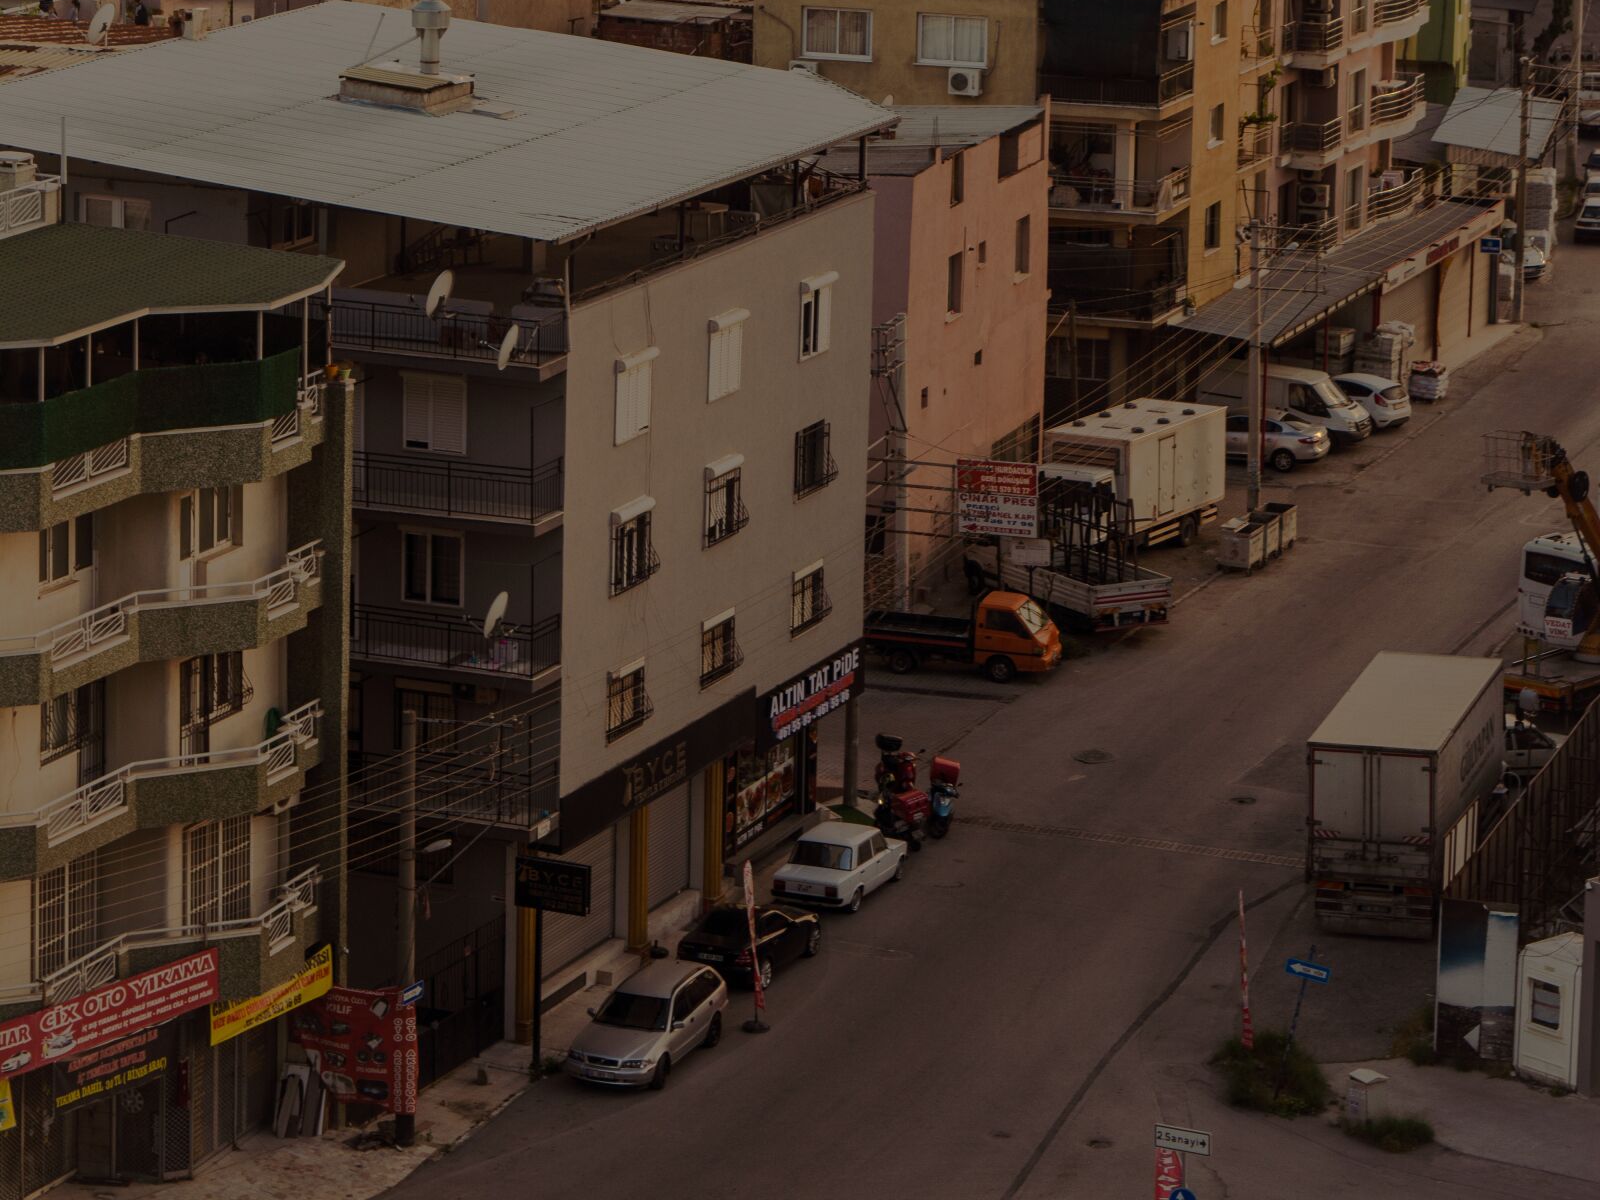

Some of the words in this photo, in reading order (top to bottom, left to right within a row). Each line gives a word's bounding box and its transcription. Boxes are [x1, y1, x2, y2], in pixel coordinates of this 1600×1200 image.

[960, 493, 998, 504] ÇINAR
[1003, 497, 1036, 507] PRES
[770, 679, 805, 718] ALTIN
[809, 665, 831, 695] TAT
[528, 868, 584, 889] BYCE
[83, 986, 127, 1016] OTO
[128, 953, 215, 999] YIKAMA
[405, 1017, 417, 1042] OTO
